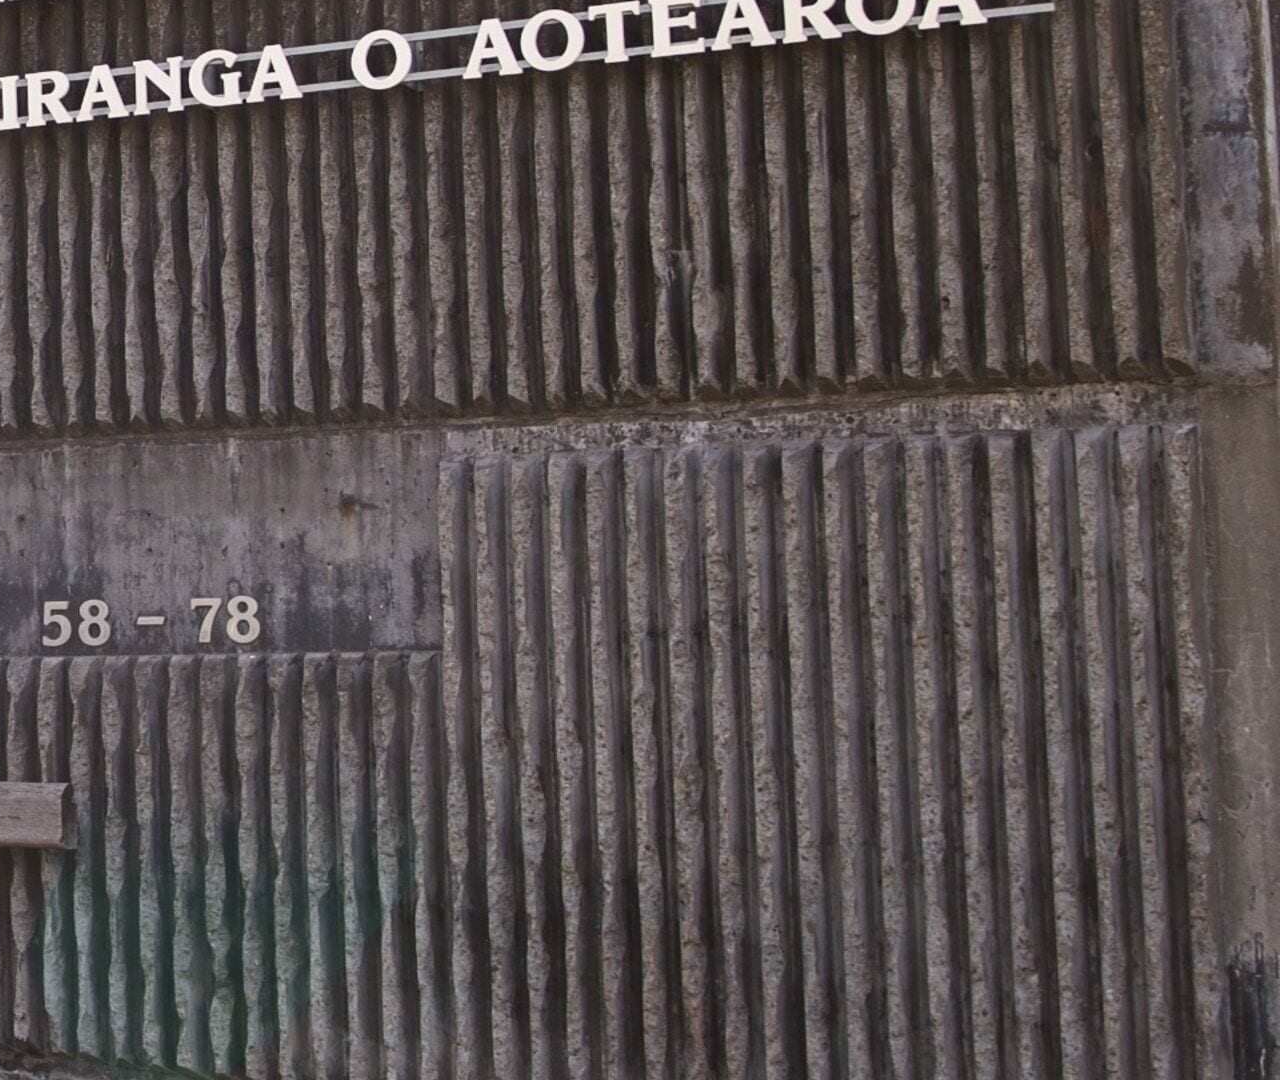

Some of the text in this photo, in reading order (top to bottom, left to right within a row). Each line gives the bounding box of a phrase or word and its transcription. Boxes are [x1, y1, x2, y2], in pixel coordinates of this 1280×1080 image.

[351, 29, 412, 90] O
[42, 599, 111, 647] 58
[190, 595, 260, 643] 78
